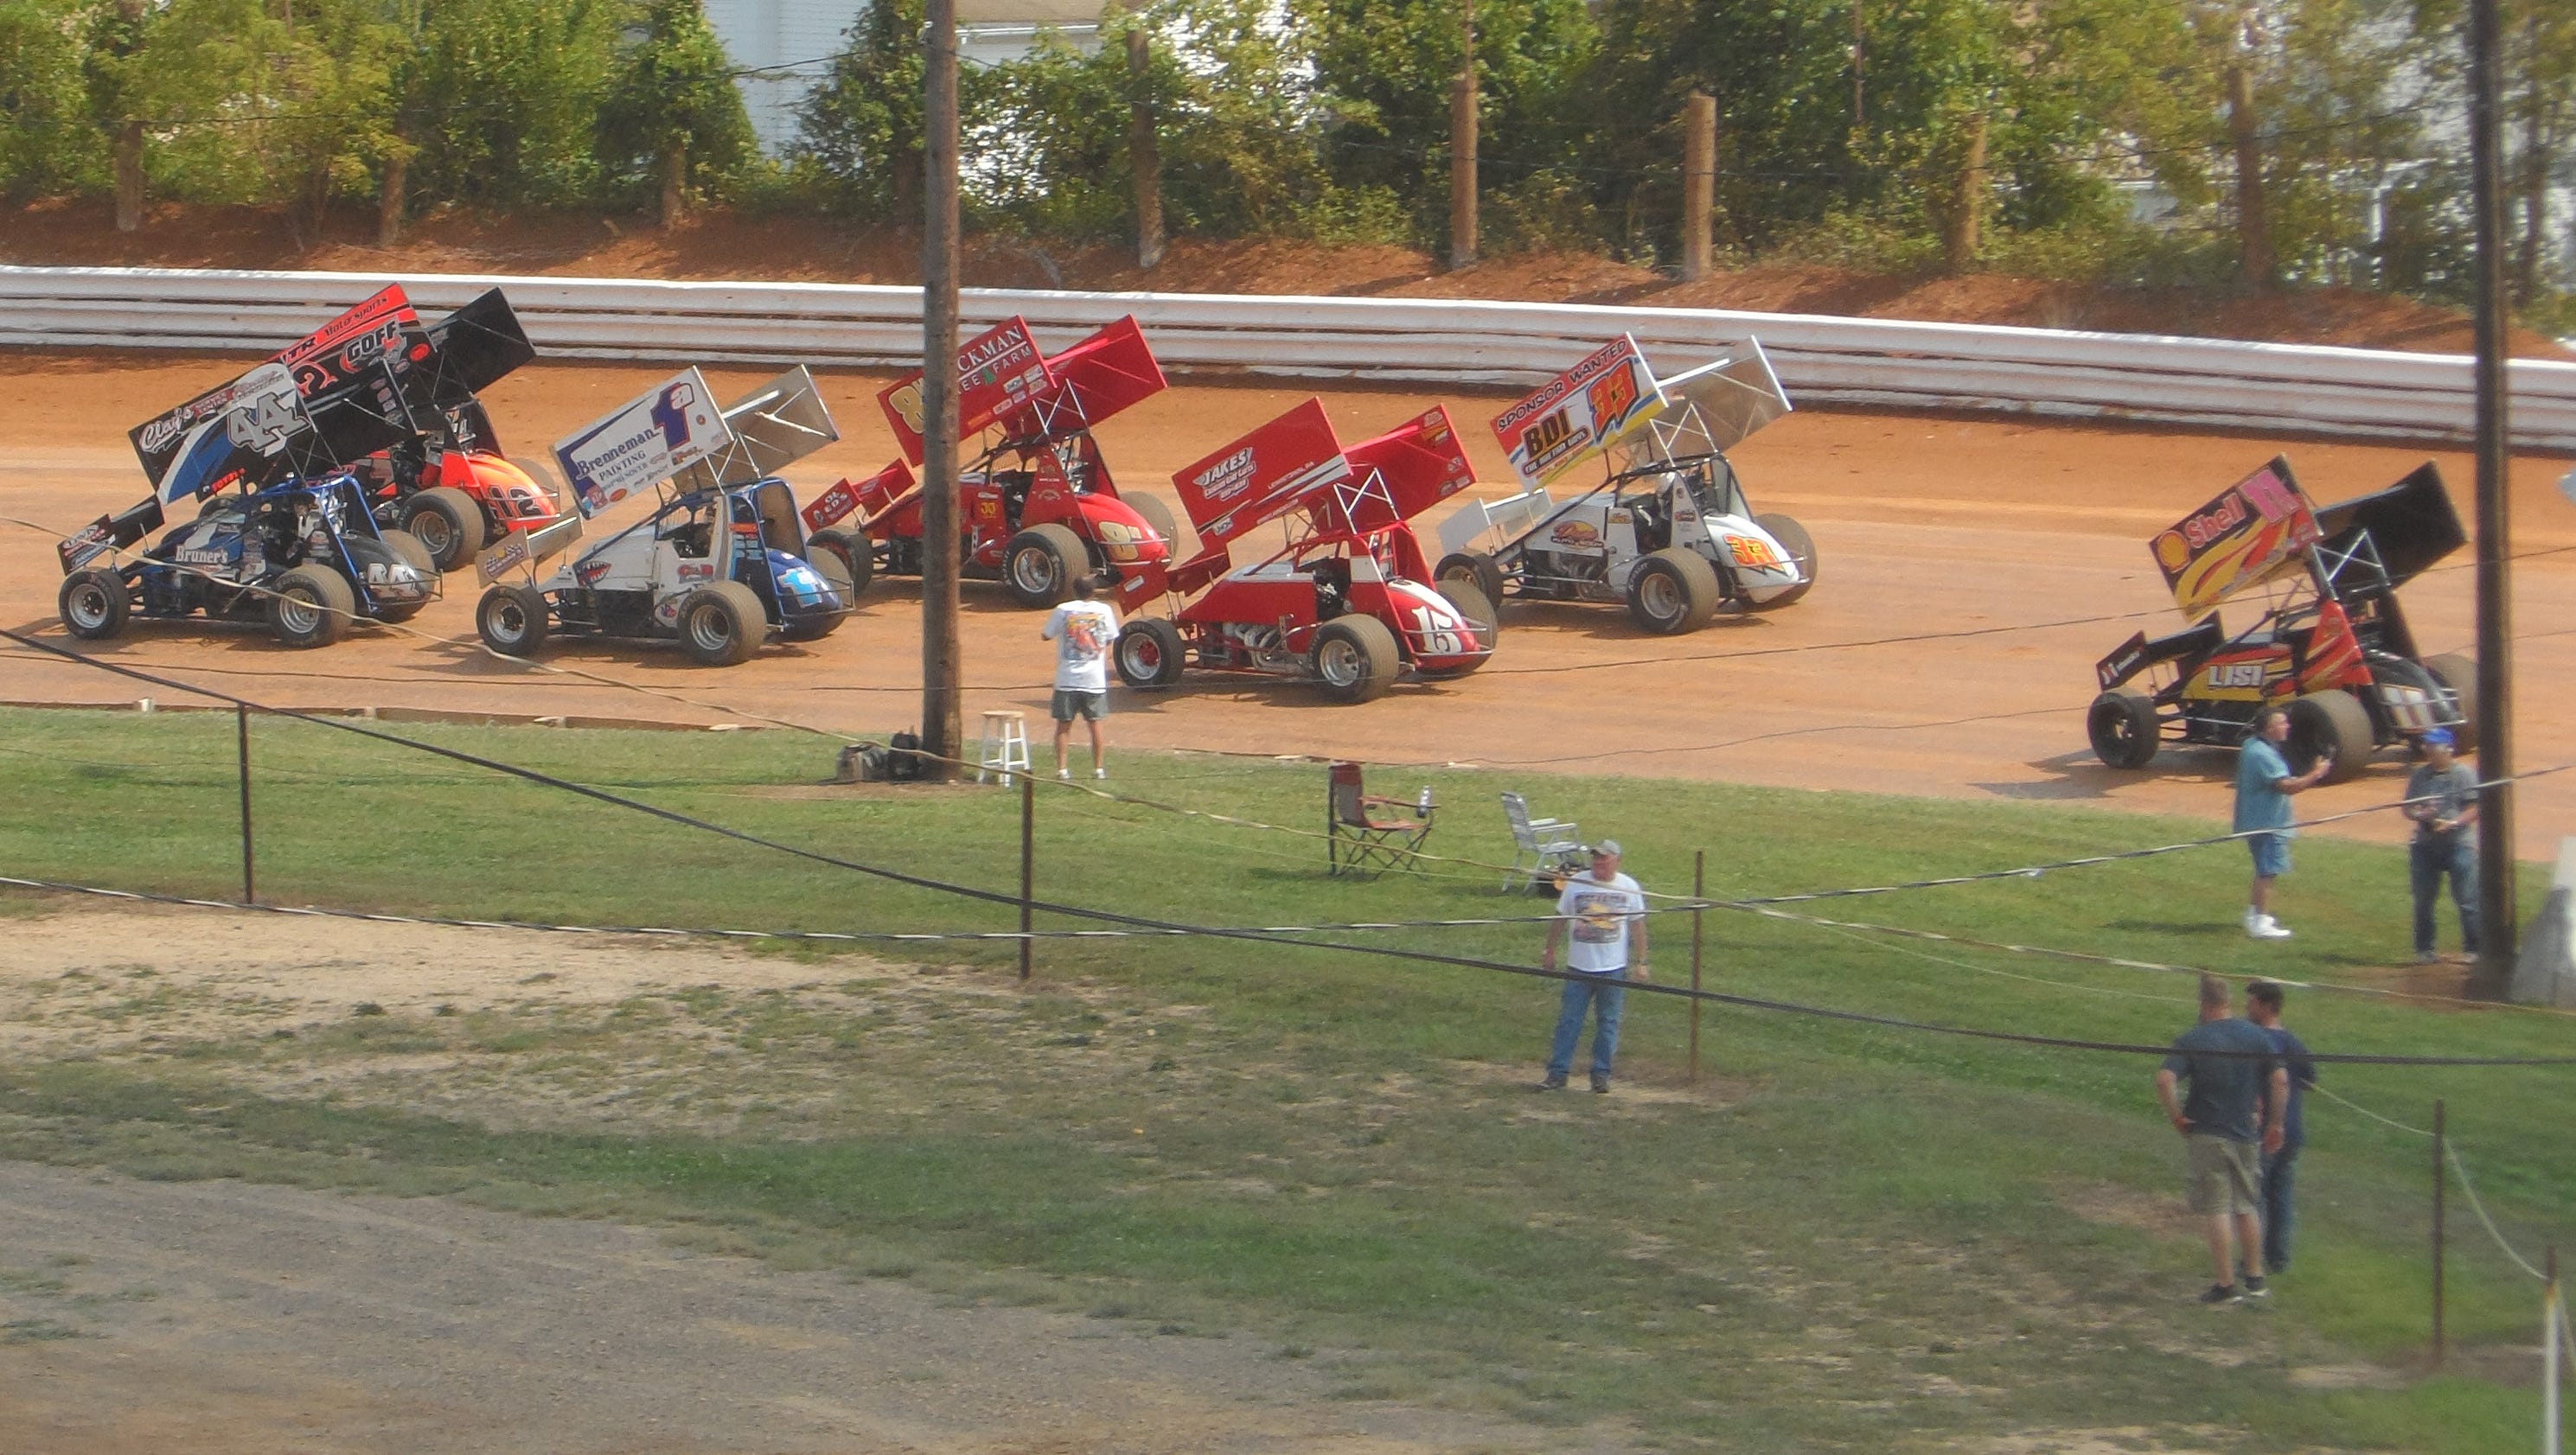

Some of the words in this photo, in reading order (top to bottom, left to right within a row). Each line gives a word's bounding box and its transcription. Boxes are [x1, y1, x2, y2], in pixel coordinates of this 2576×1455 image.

[346, 320, 398, 361] GOFF
[957, 326, 1024, 373] CKMAN
[994, 346, 1033, 374] FARM
[1496, 381, 1564, 432] SPONSOR
[1569, 341, 1627, 383] WANTED
[138, 406, 195, 453] Clay's
[227, 392, 311, 453] 44
[577, 427, 660, 475] Brenneman
[598, 450, 647, 482] PAINTING
[1203, 450, 1249, 486] JAKES
[490, 486, 541, 519] 12
[2185, 493, 2247, 548] Shell
[176, 546, 229, 564] Bruner's
[366, 563, 423, 599] 44
[1411, 605, 1462, 654] 15
